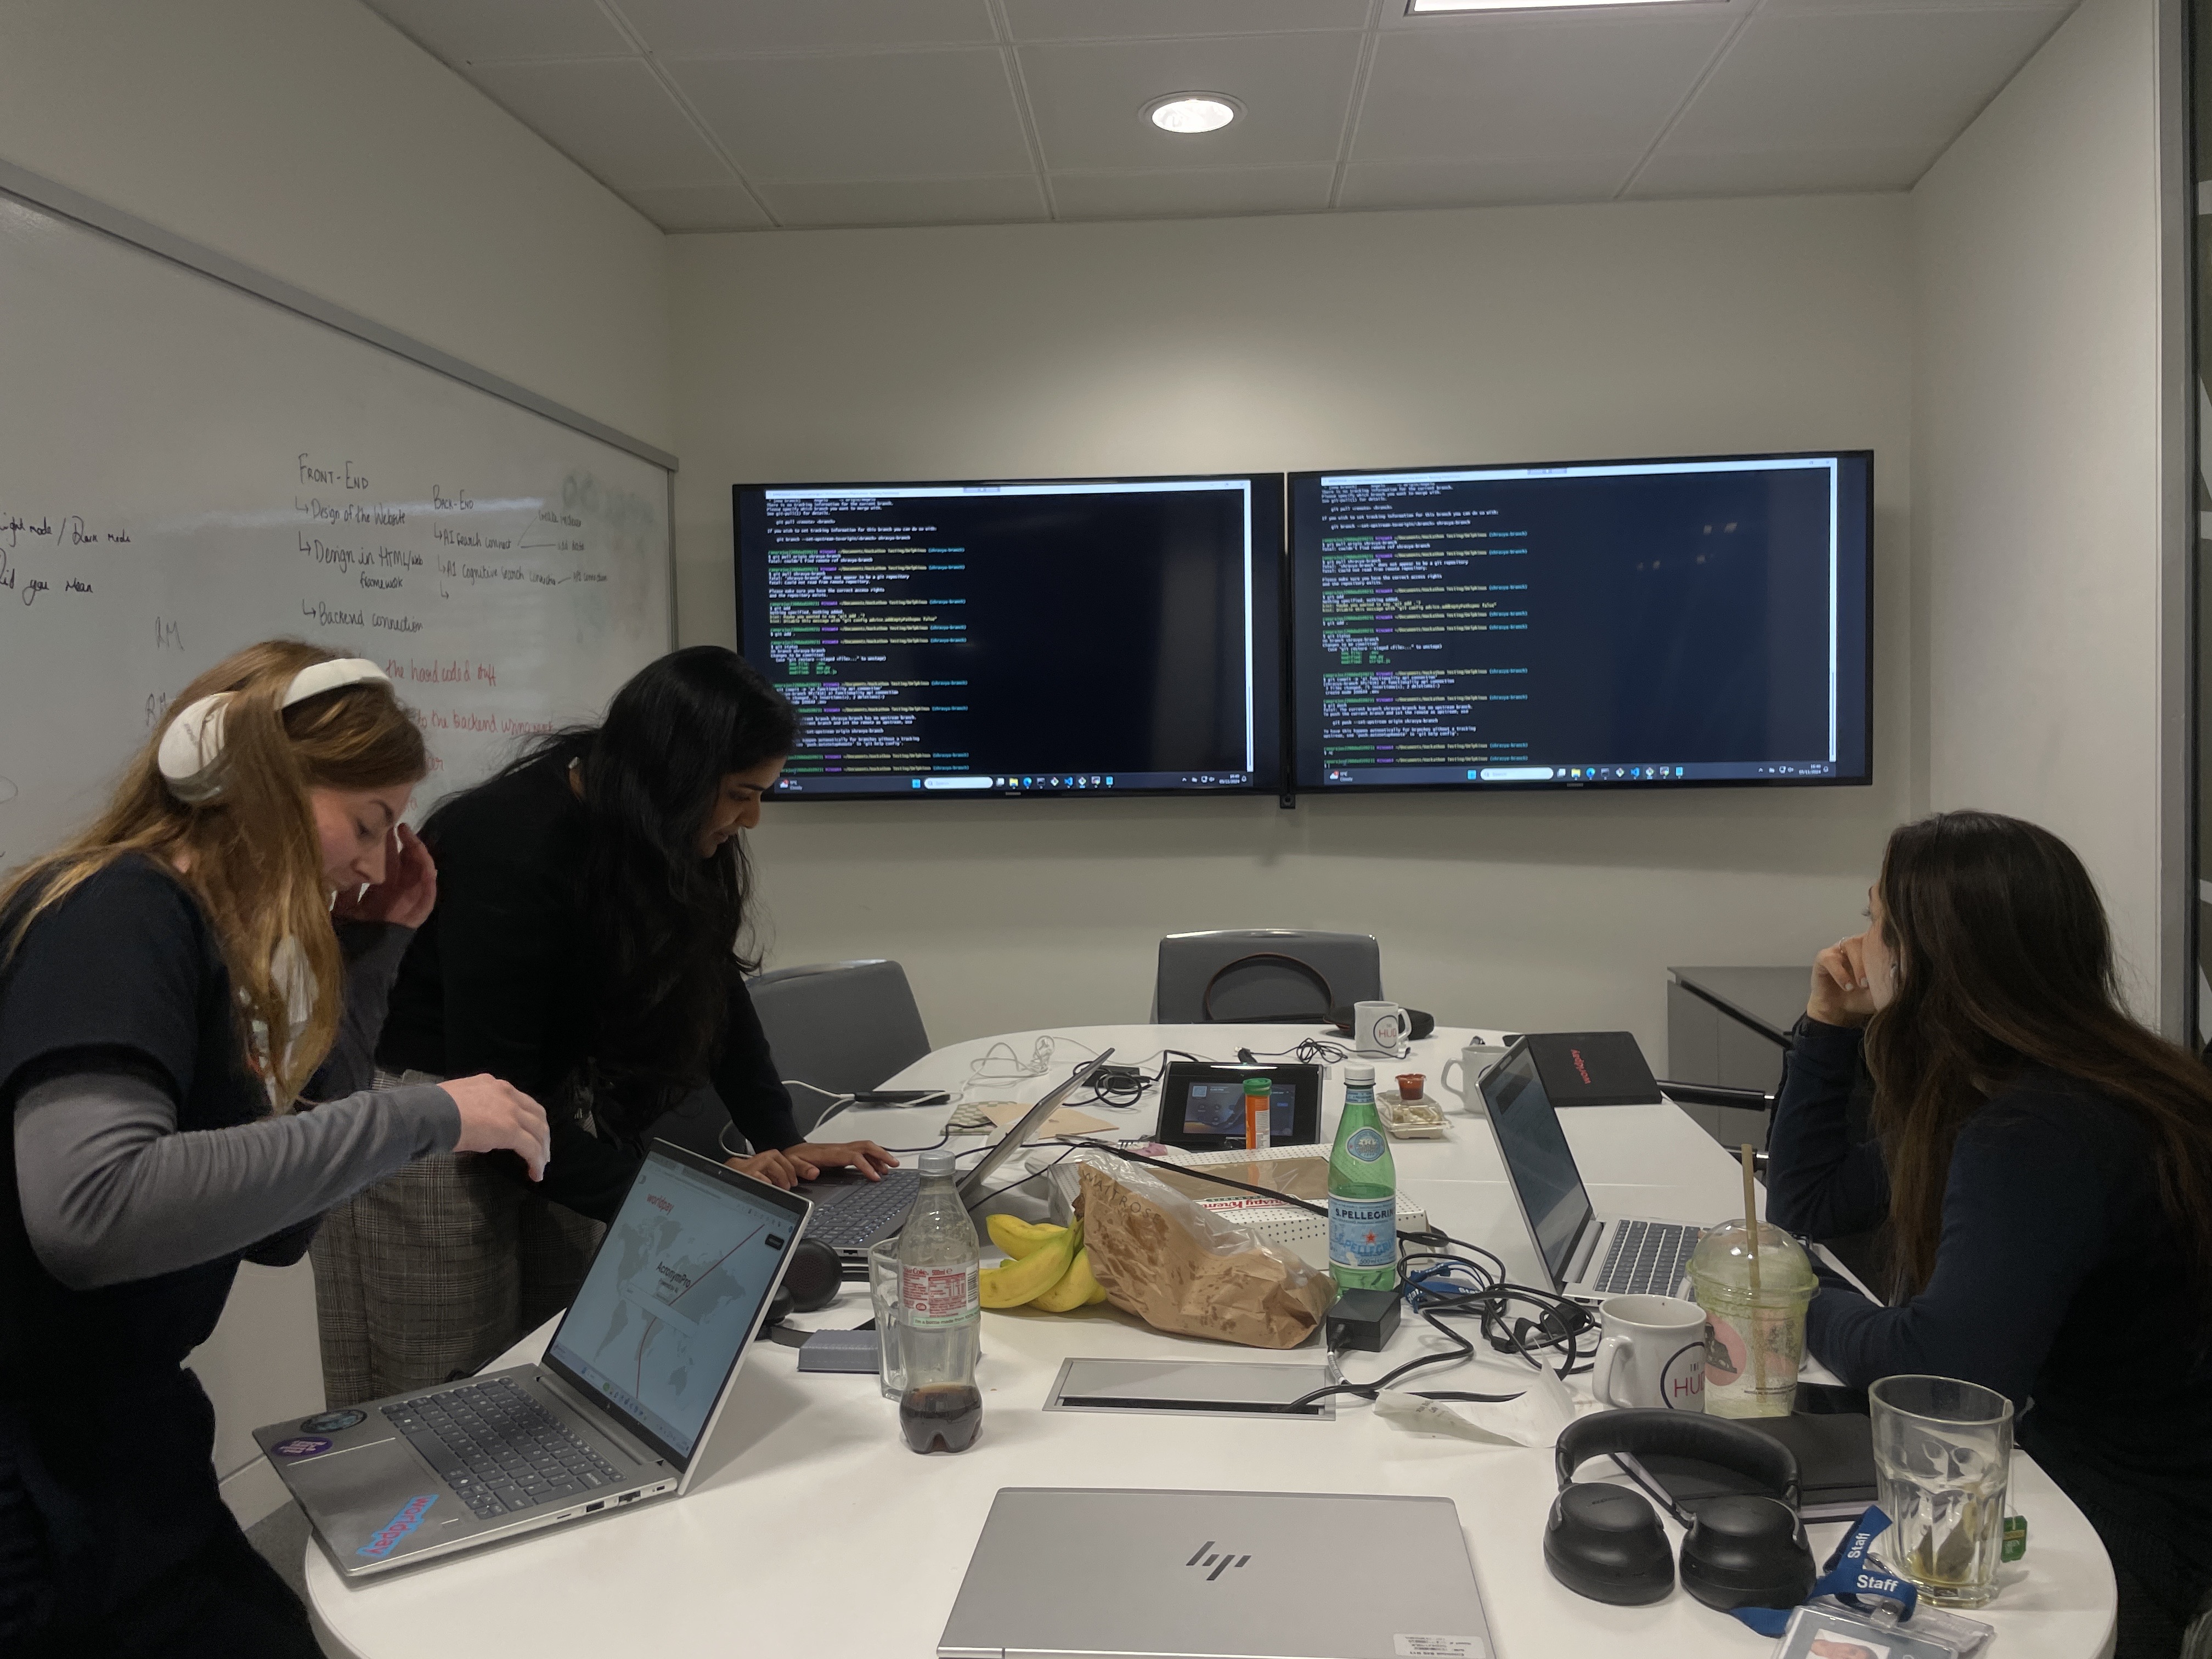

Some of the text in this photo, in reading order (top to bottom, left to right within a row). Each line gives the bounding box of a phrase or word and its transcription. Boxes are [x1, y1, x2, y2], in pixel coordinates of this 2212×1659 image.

[311, 498, 340, 524] Design
[344, 504, 353, 522] of
[356, 505, 370, 523] the
[358, 547, 375, 565] in
[22, 579, 49, 606] you
[431, 709, 449, 729] the
[647, 1192, 674, 1215] worldpay
[1848, 1533, 1870, 1559] Staff
[1185, 1541, 1252, 1581] hp
[1857, 1575, 1899, 1592] Staff
